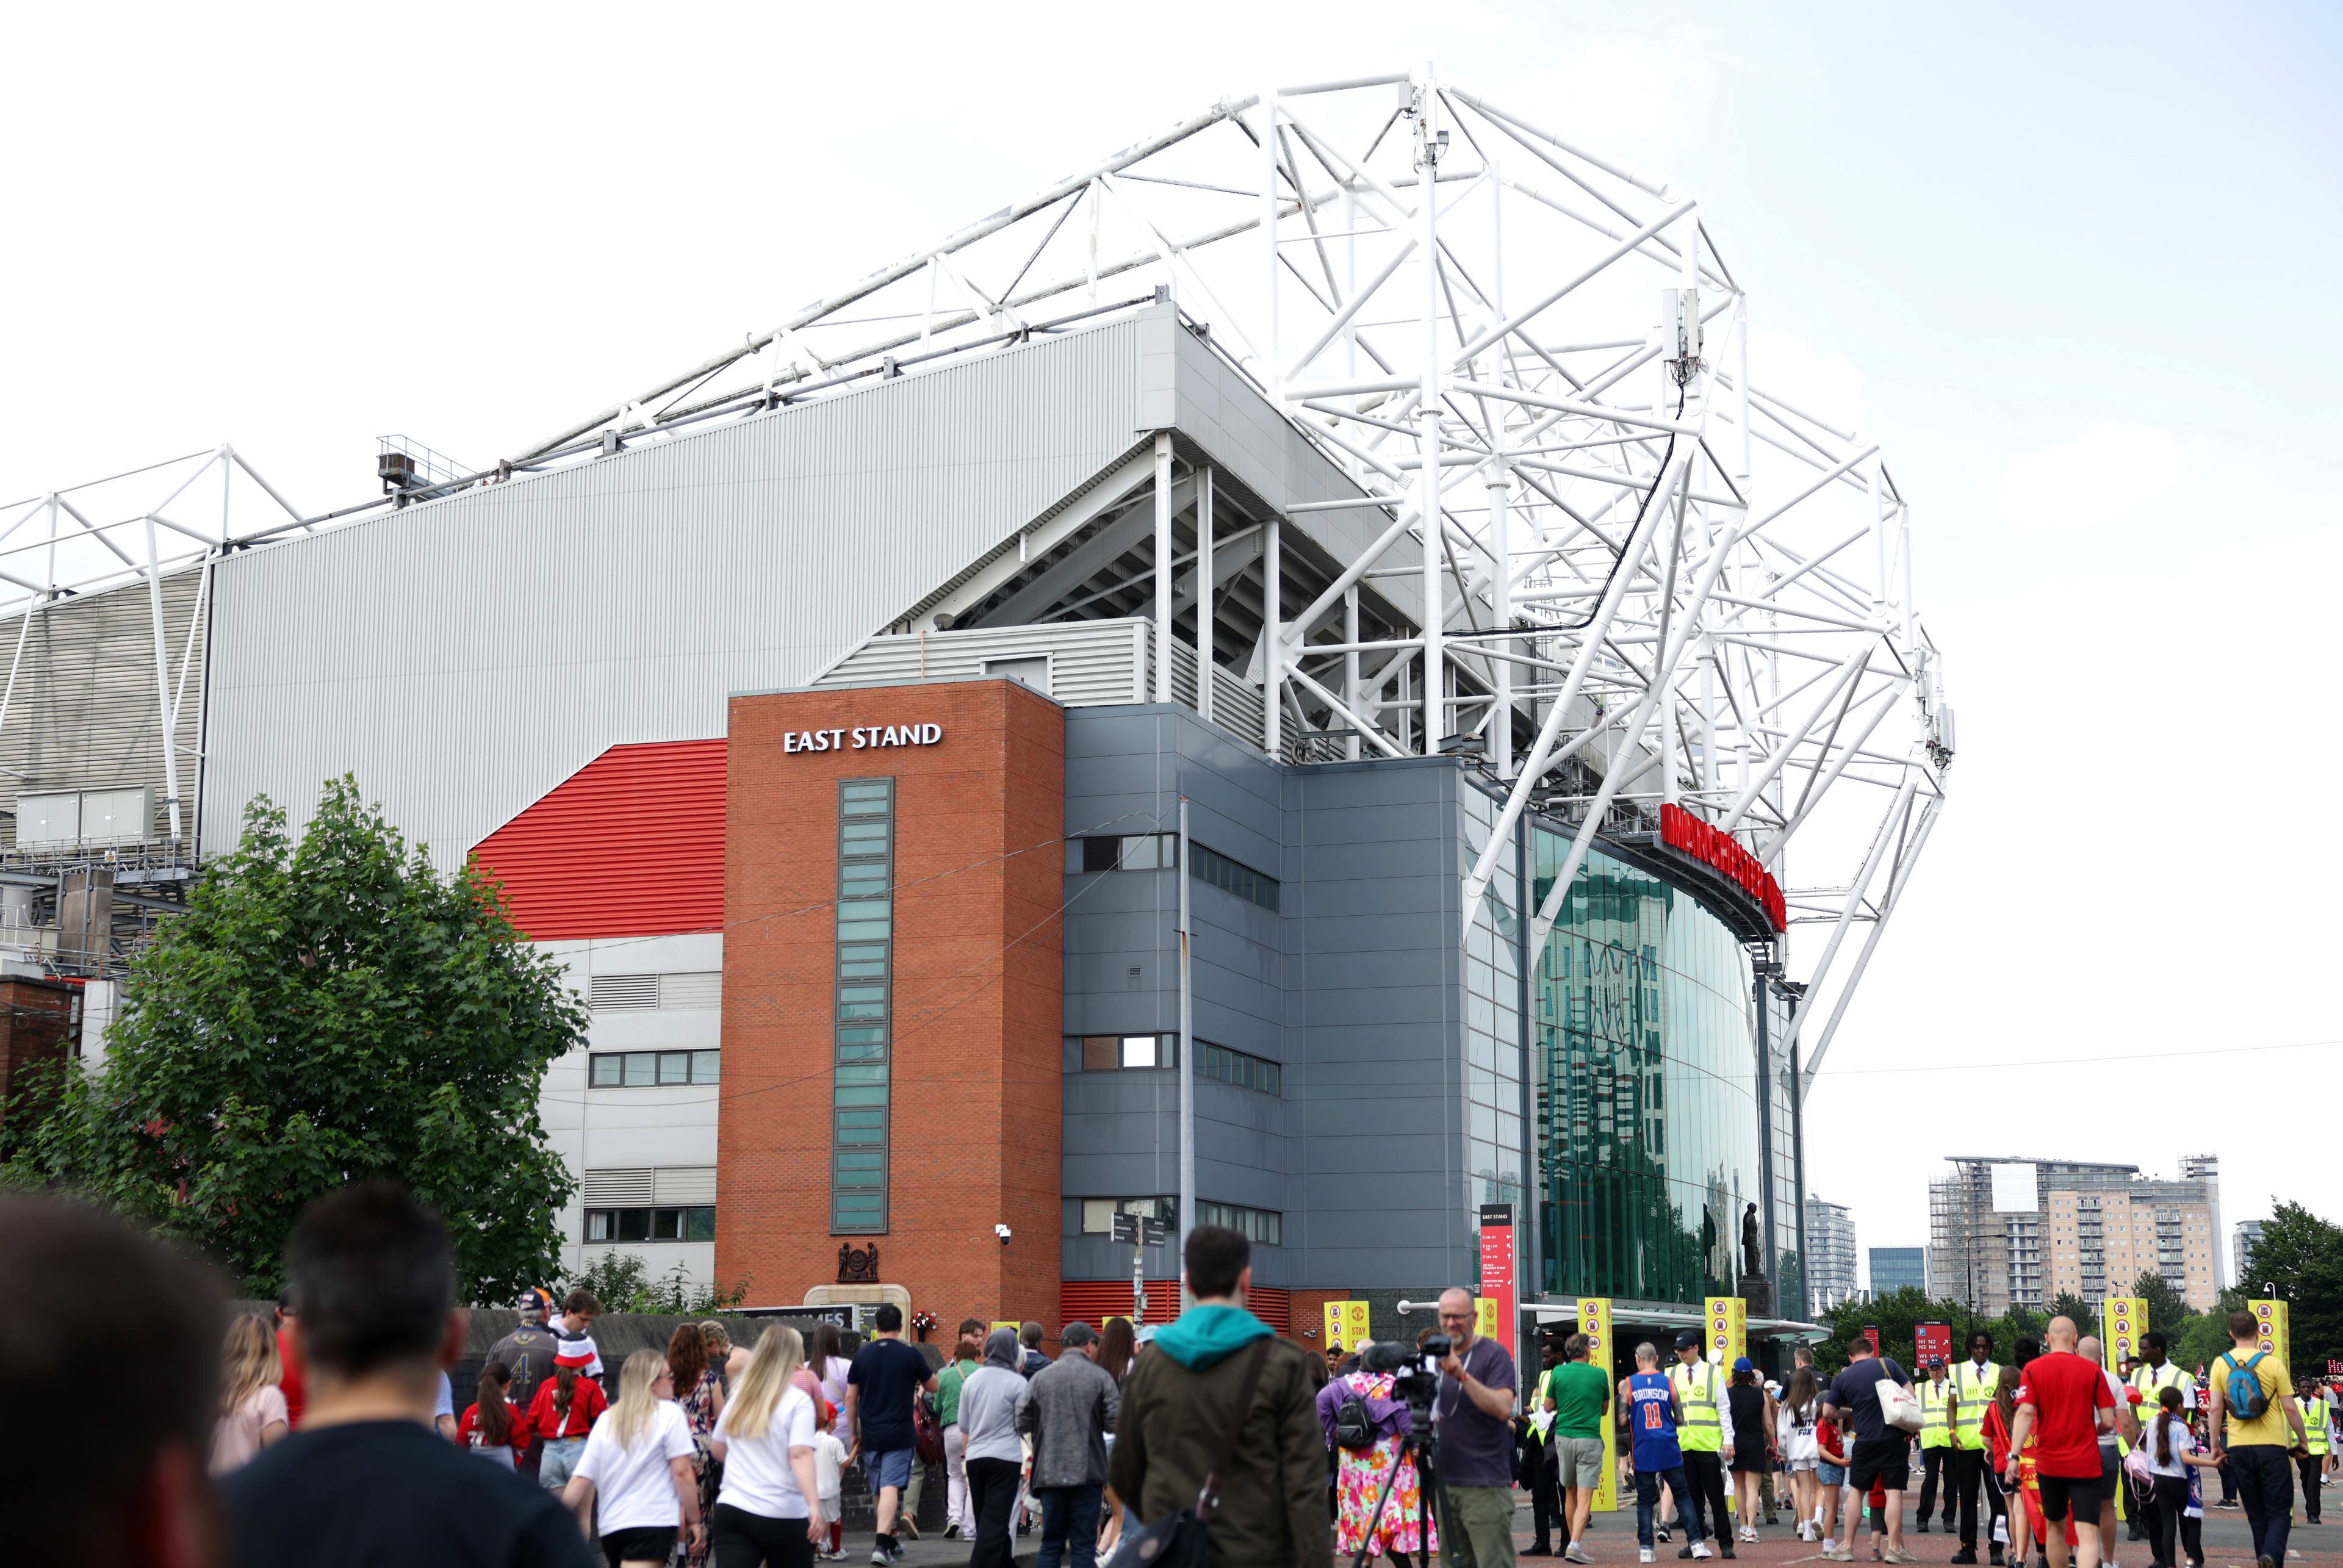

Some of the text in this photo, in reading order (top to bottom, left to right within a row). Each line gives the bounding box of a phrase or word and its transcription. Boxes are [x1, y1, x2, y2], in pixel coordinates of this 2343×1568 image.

[783, 723, 943, 753] EAST STAND
[1660, 803, 1763, 901] MANCHESTER
[1351, 1327, 1366, 1336] STAY
[1486, 1324, 1495, 1332] STAY
[510, 1353, 531, 1384] 4
[1632, 1388, 1669, 1402] BRUNSON
[1643, 1403, 1662, 1430] 11
[1791, 1419, 1816, 1428] WIT
[1798, 1428, 1813, 1436] FOX
